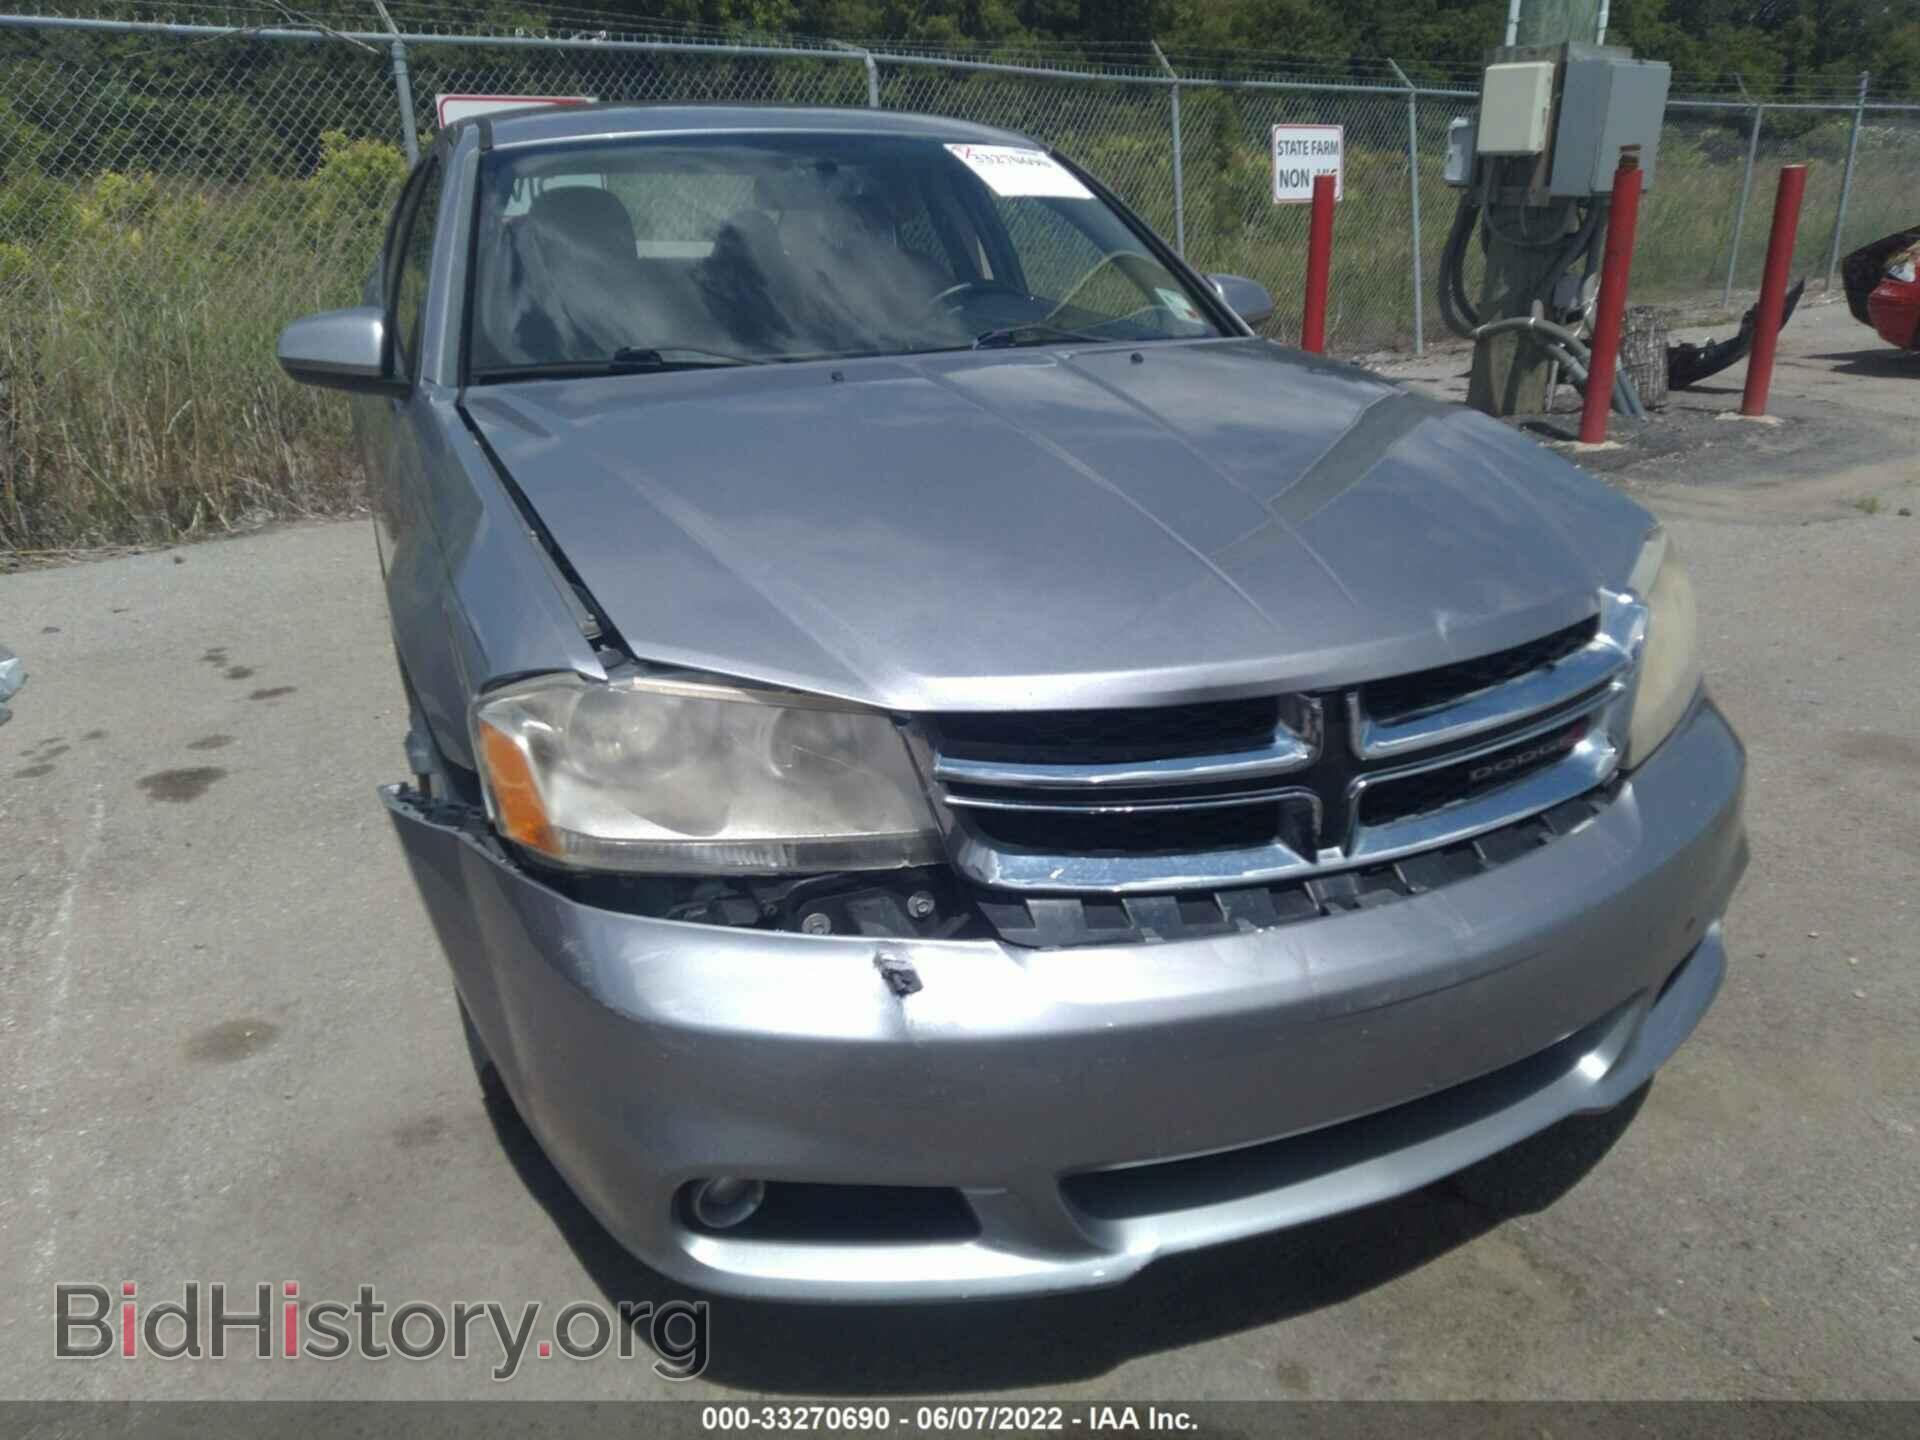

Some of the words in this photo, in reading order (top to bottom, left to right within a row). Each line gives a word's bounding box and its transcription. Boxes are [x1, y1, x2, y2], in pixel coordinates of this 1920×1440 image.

[1277, 139, 1309, 156] STATE
[1311, 140, 1339, 156] FARM
[1279, 168, 1310, 188] NON
